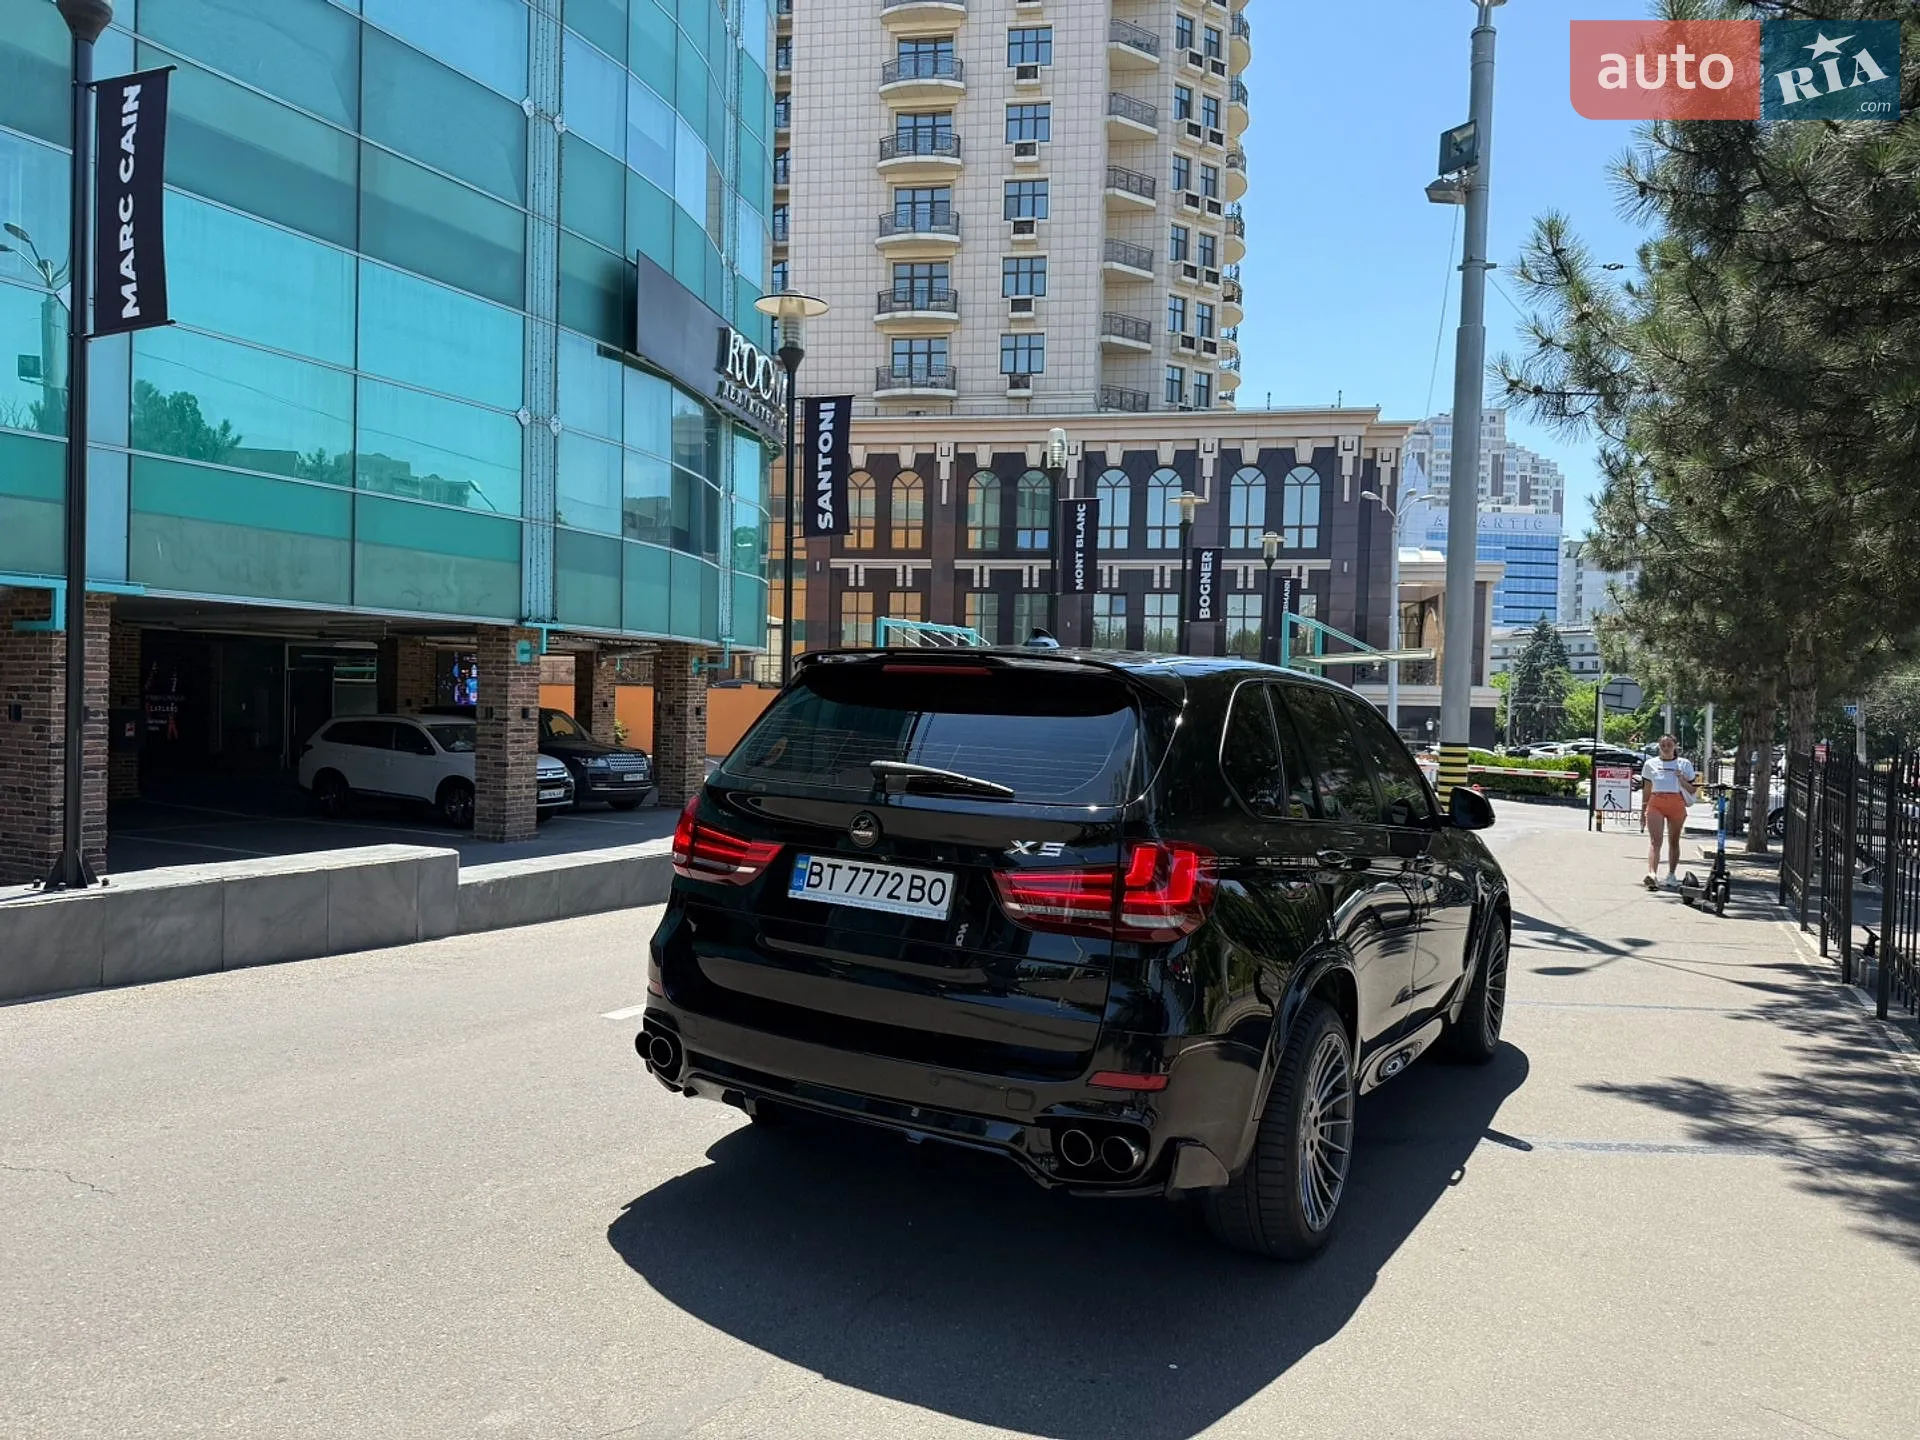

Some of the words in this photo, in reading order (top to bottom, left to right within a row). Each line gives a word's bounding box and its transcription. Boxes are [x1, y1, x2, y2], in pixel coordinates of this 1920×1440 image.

[119, 83, 142, 184] CAIN
[119, 193, 141, 319] MARC
[817, 401, 836, 530] SANTONI
[1076, 503, 1087, 548] BLANC
[1434, 514, 1544, 530] AANTIC
[1075, 551, 1085, 590] MONT
[1199, 550, 1213, 619] BOGNER
[1003, 840, 1066, 857] X5
